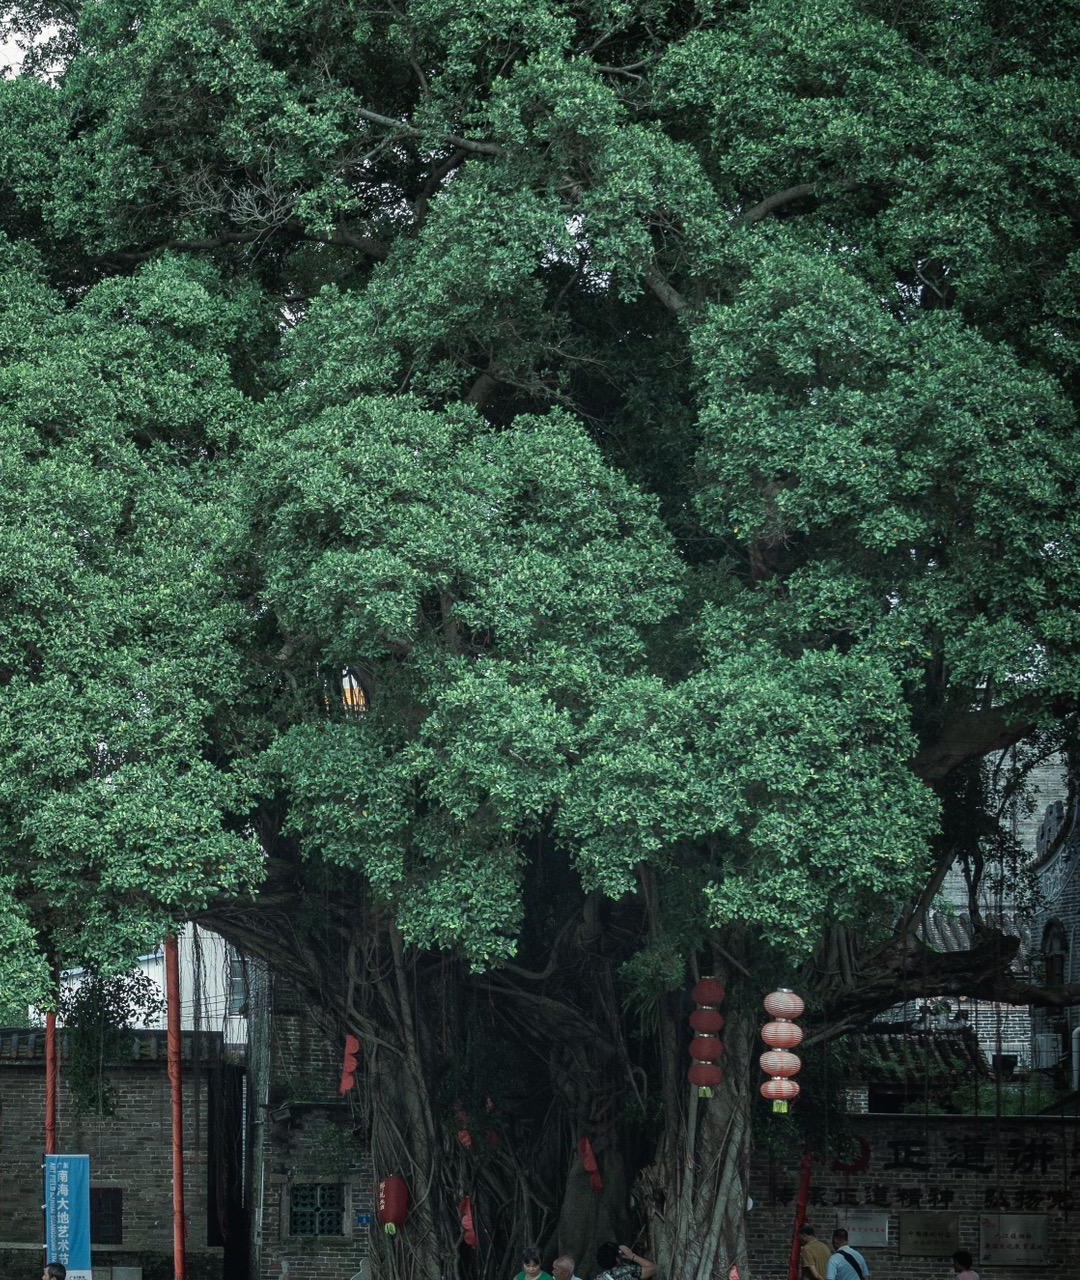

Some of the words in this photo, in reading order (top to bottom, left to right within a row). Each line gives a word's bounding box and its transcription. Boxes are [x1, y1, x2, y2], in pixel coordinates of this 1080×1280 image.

[57, 1170, 70, 1265] 南海大地艺术节
